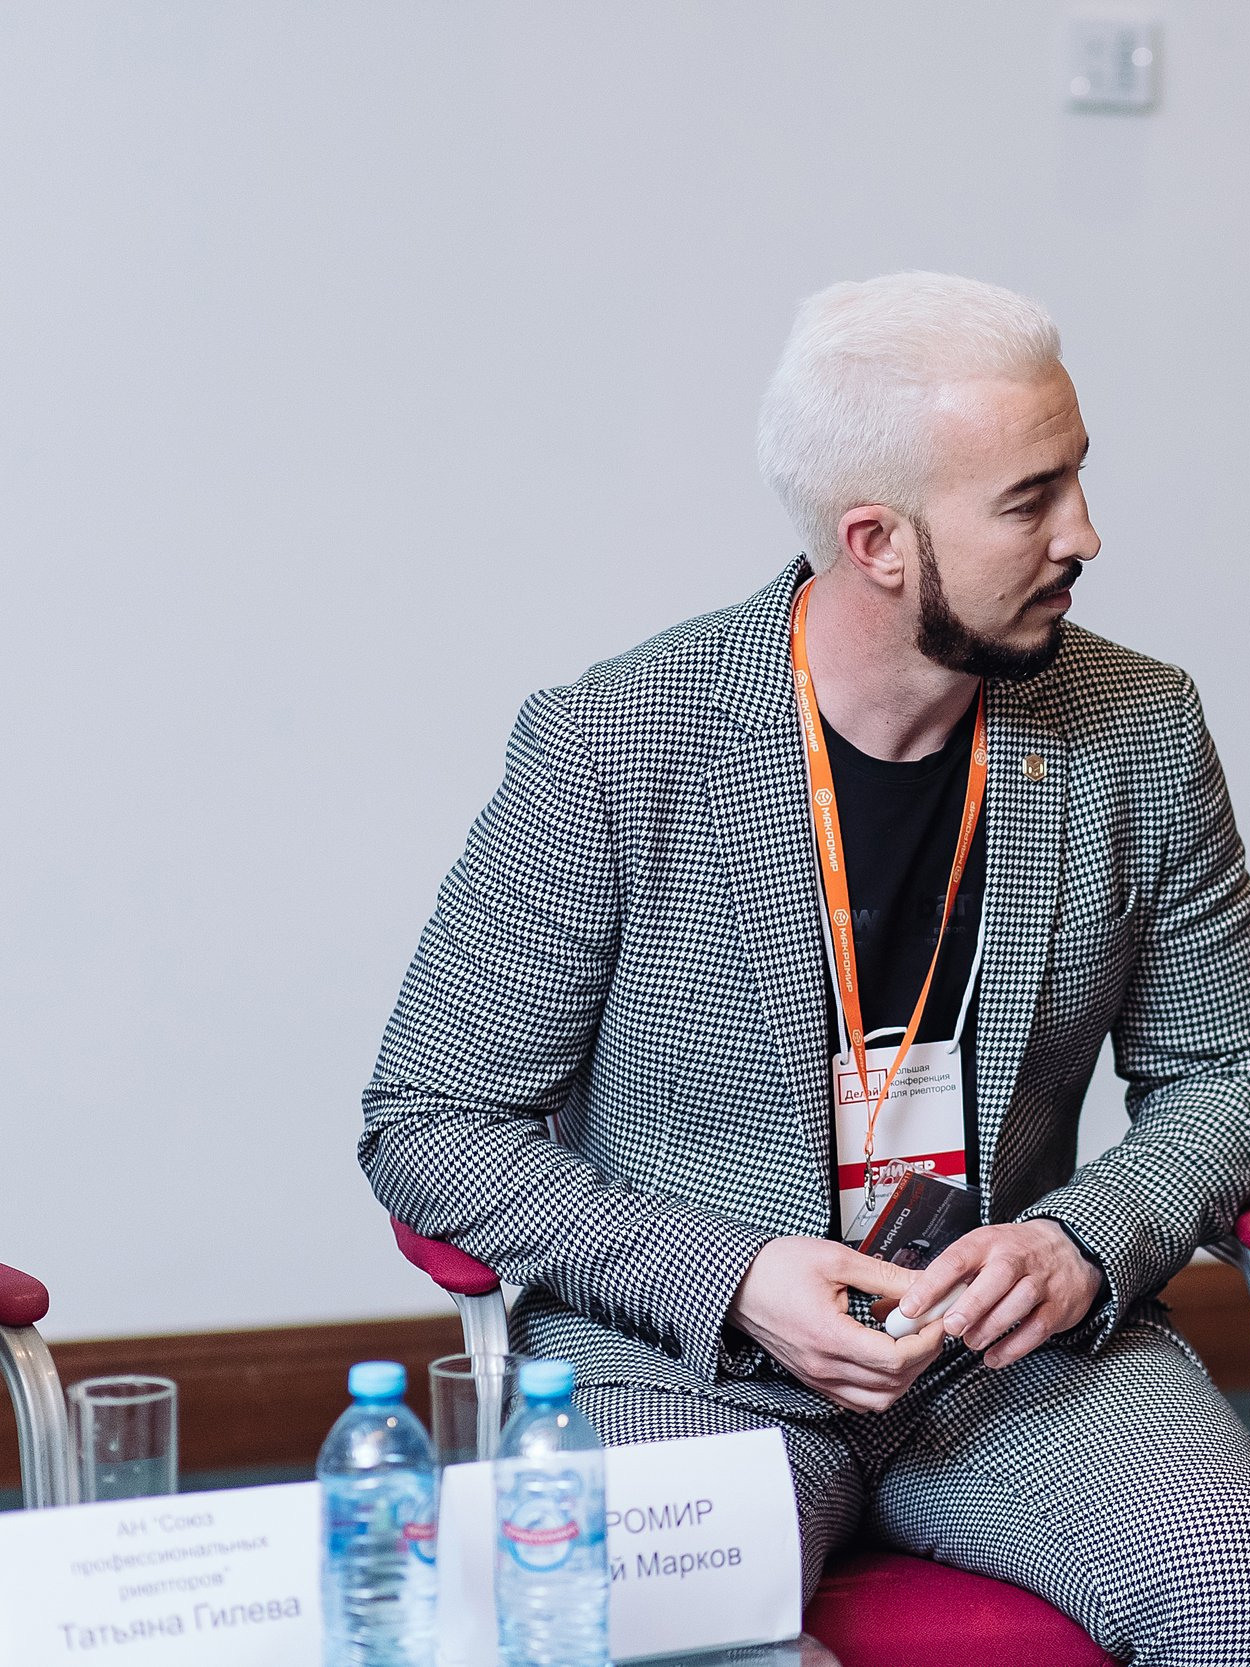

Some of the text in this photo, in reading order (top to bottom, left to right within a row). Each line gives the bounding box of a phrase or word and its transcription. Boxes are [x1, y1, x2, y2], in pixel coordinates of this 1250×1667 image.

[800, 688, 819, 752] МАКРОМИР
[820, 806, 839, 872] МАКРОМИР
[958, 801, 976, 865] МАКРОМИР
[840, 928, 853, 993] МАКРОМИР
[890, 1074, 950, 1087] конференция
[890, 1084, 957, 1099] для риелторов
[895, 1065, 930, 1075] ольшая
[606, 1499, 713, 1534] РОМИР
[70, 1534, 269, 1577] профессиональных
[636, 1547, 742, 1580] Марков
[58, 1595, 302, 1651] Татьяна Гилева
